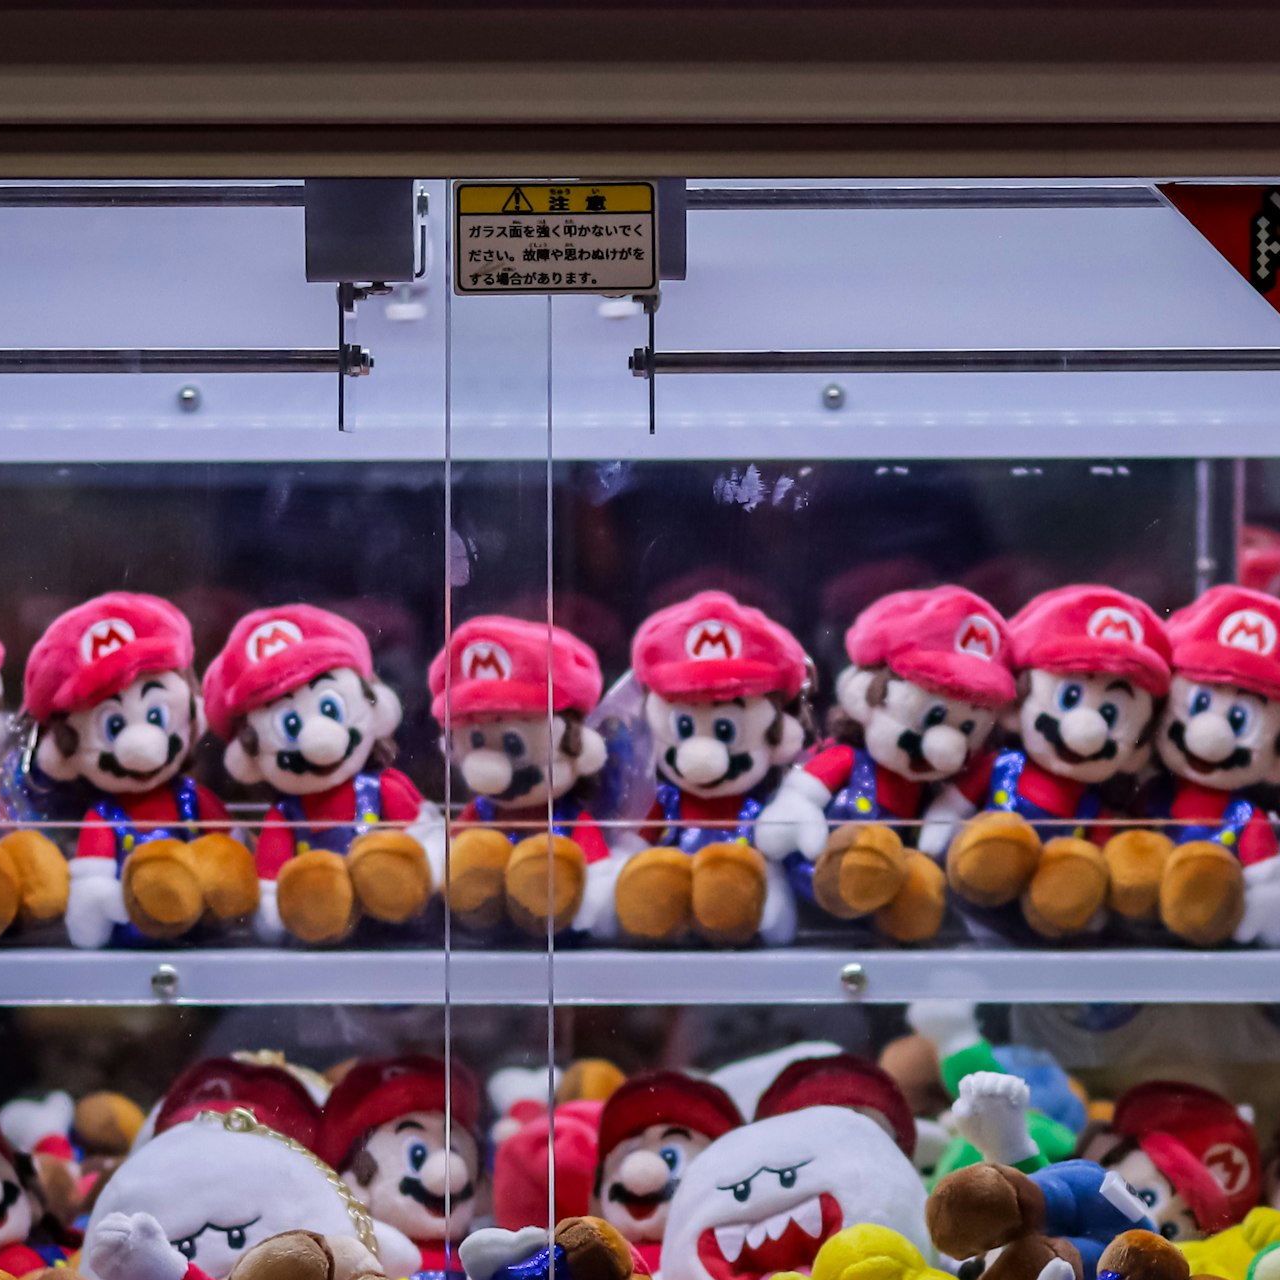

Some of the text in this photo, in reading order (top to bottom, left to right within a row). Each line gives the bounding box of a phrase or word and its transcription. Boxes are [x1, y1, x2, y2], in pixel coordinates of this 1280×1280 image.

[548, 196, 607, 211] 注意
[468, 225, 643, 238] ガラス面を強く叩かないでく
[468, 248, 645, 262] ださい。故障や思わぬけがを
[469, 270, 598, 285] する場合があります。
